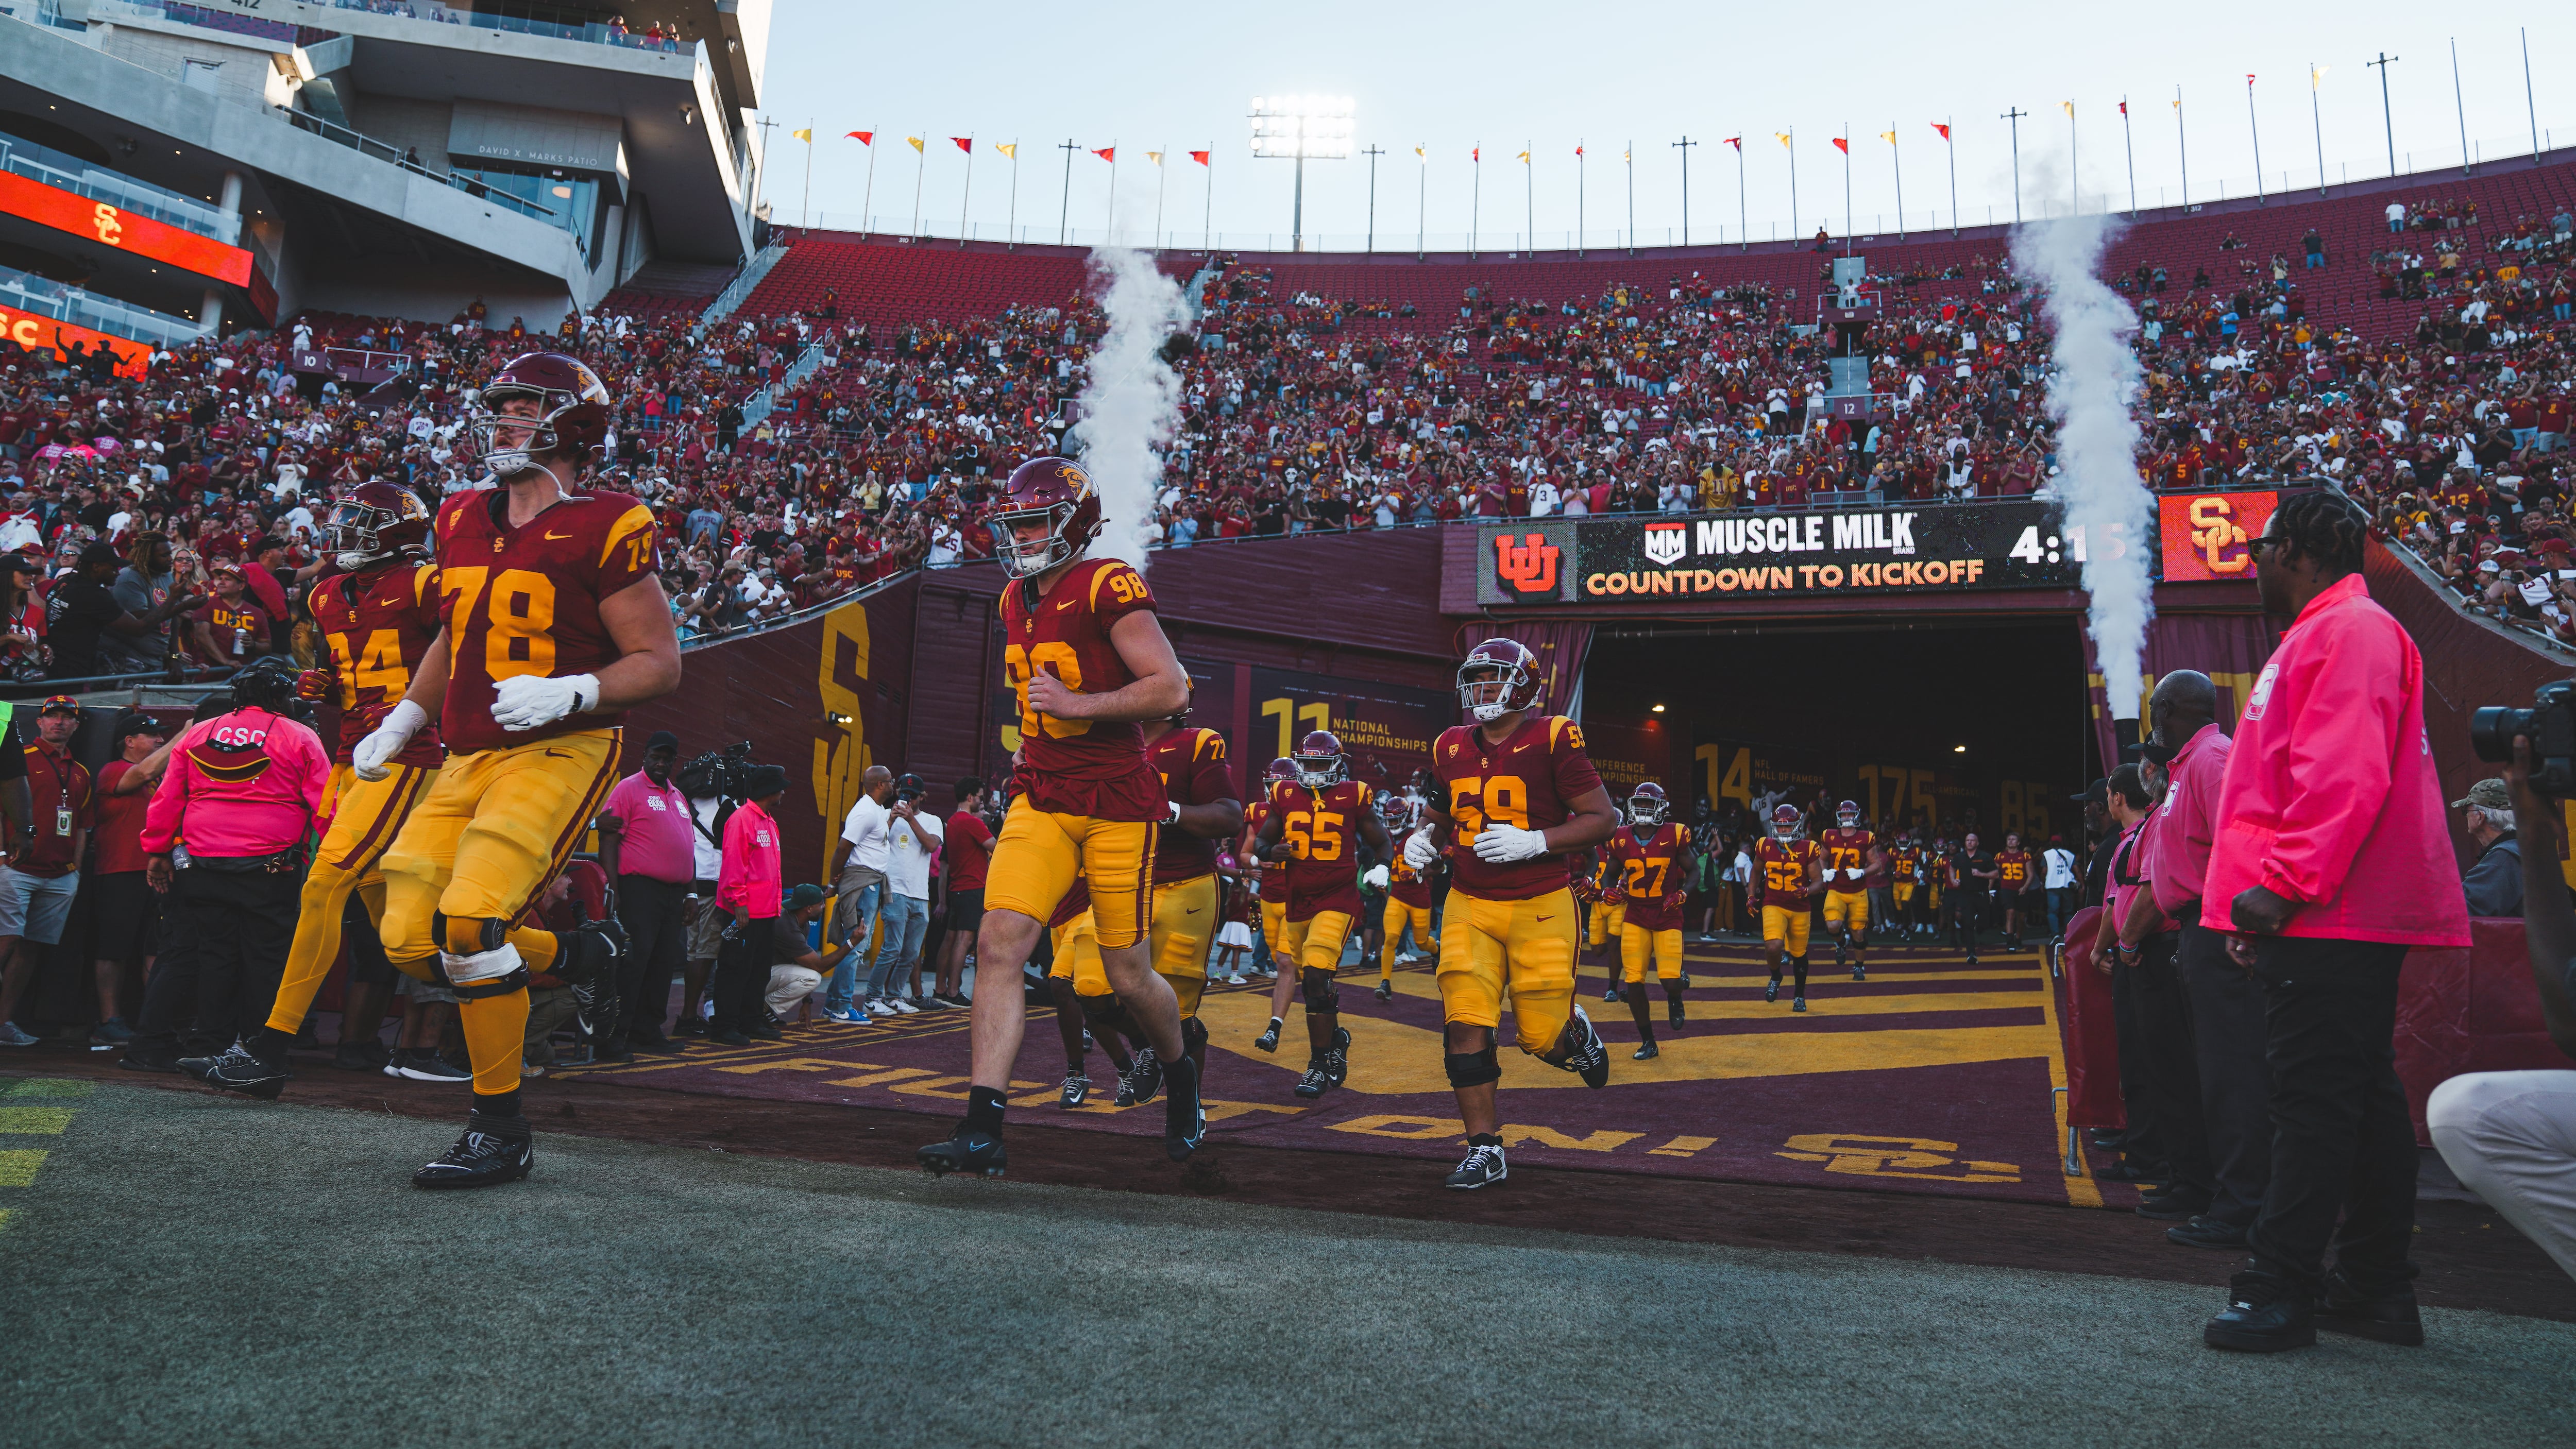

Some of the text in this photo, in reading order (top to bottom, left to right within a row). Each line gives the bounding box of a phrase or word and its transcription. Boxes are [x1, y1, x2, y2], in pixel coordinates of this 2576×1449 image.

[479, 145, 510, 157] DAVID
[529, 151, 563, 163] MARKS
[568, 155, 598, 167] PATIO
[94, 202, 122, 245] SC
[304, 355, 315, 367] 10
[1844, 403, 1855, 414] 12
[1540, 490, 1547, 502] 3
[1711, 479, 1726, 496] 11
[1697, 512, 1915, 555] MUSCLE MILK
[2190, 497, 2248, 574] SC
[1892, 547, 1916, 555] BRAND
[836, 569, 854, 578] USC
[1587, 559, 1984, 596] COUNTDOWN TO KICKOFF
[1109, 573, 1148, 604] 98
[213, 609, 254, 631] USC
[440, 566, 556, 683] 78
[1004, 641, 1094, 739] 98
[215, 726, 266, 747] CSC
[1262, 697, 1330, 758] 11
[1333, 718, 1391, 735] NATIONAL
[1210, 739, 1225, 760] 77
[1333, 730, 1427, 752] CHAMPIONSHIPS
[1590, 758, 1645, 773] ONFERENCE
[1755, 758, 1770, 770] NFL
[1696, 743, 1751, 812] 14
[1755, 770, 1824, 785] HALL OF FAMERS
[647, 799, 667, 808] 8000
[1858, 765, 1936, 830] 175
[1450, 776, 1529, 846] 59
[2001, 780, 2050, 842] 85
[1285, 811, 1344, 861] 65
[1831, 847, 1860, 870] 73
[1625, 857, 1670, 898] 27
[1765, 862, 1803, 892] 52
[2002, 863, 2024, 880] 35
[1773, 1133, 2021, 1183] SC
